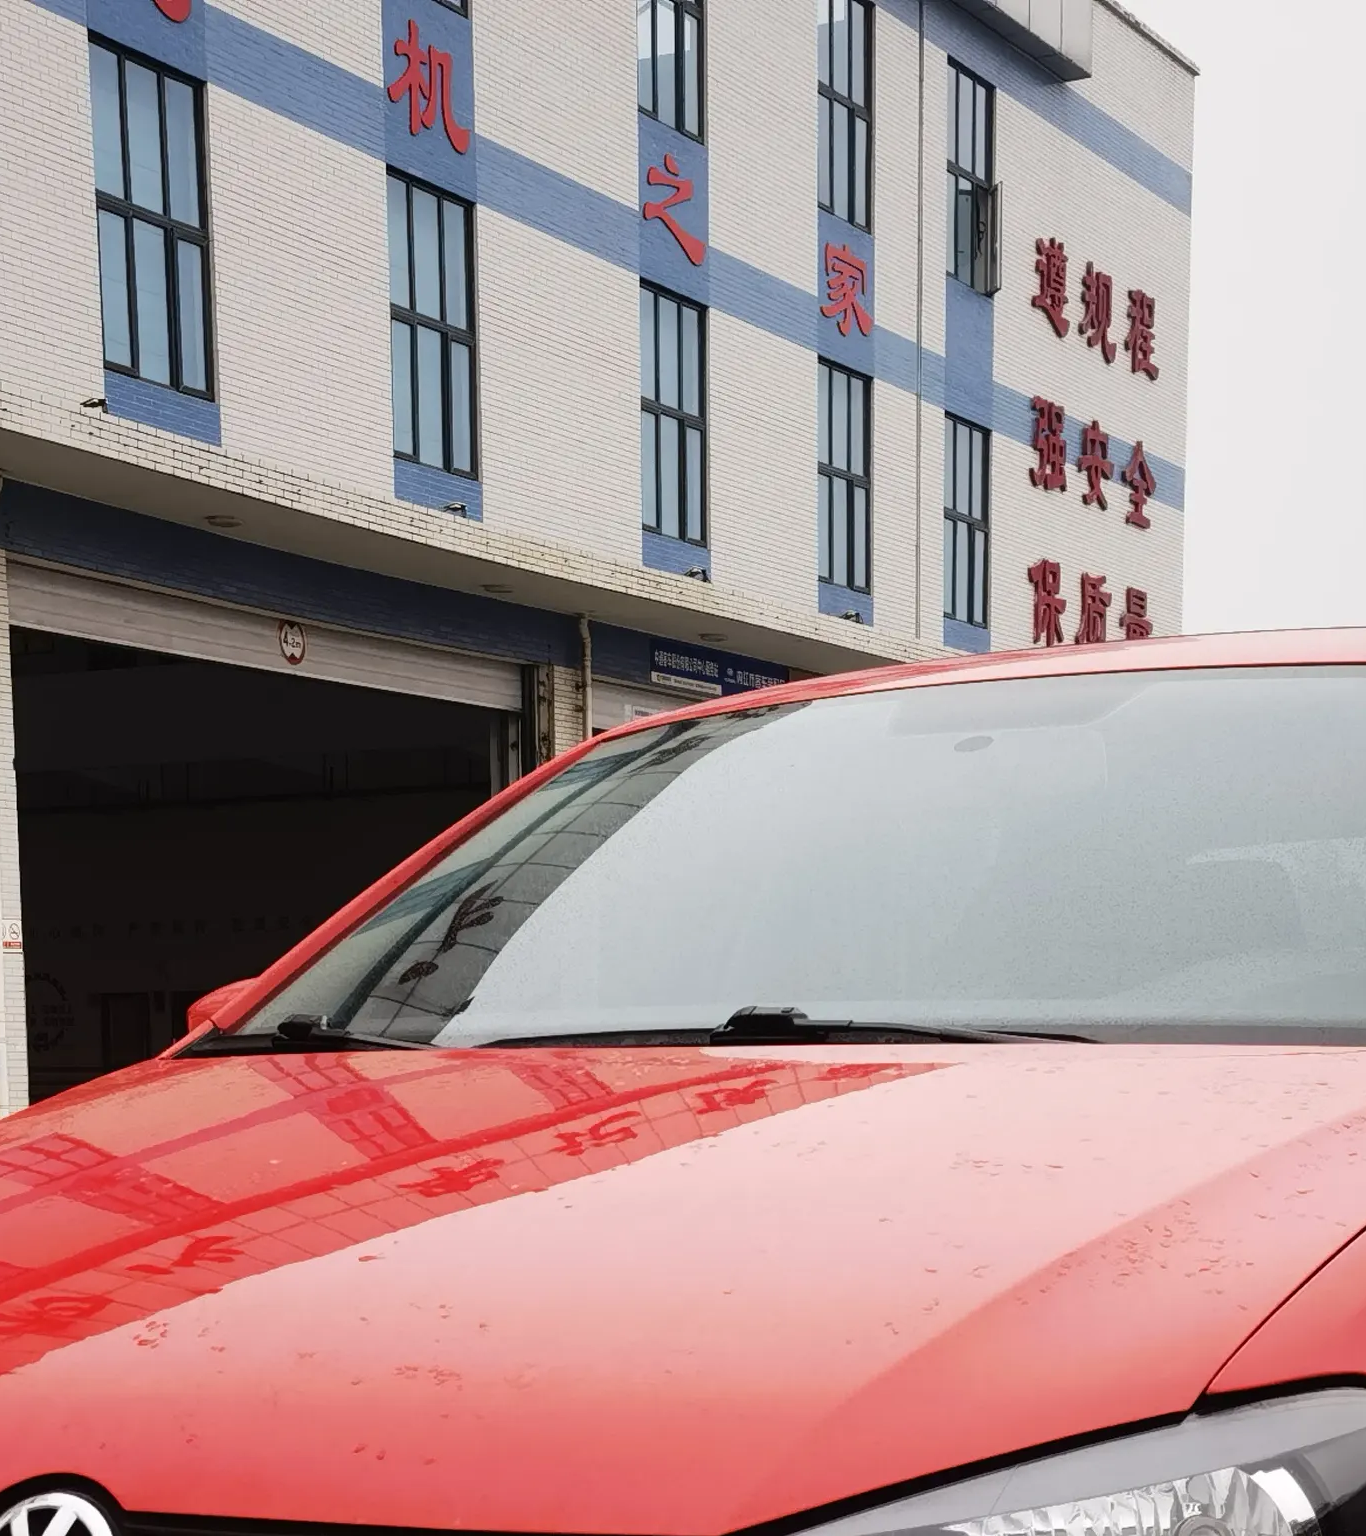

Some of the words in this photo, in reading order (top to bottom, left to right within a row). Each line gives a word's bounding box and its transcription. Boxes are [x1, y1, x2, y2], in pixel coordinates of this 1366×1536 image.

[1031, 237, 1159, 381] 遵规程
[1029, 396, 1156, 529] 强安全
